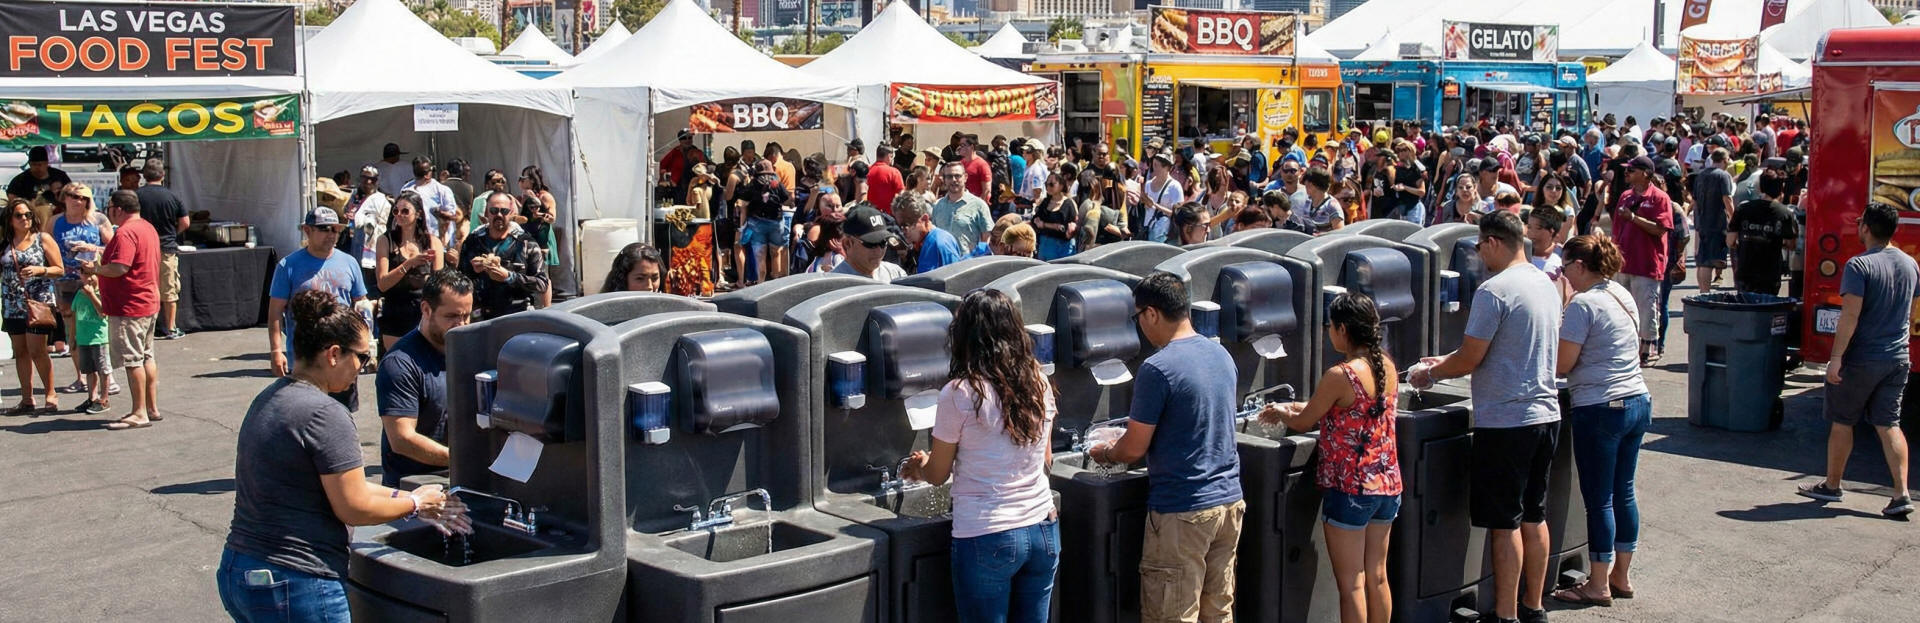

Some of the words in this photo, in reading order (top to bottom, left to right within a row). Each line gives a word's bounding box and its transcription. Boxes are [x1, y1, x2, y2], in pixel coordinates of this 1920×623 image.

[59, 9, 118, 32] LAS
[126, 10, 226, 33] VEGAS
[1197, 16, 1253, 51] BBQ
[9, 36, 150, 71] FOOD
[165, 37, 274, 71] FEST
[1471, 28, 1532, 50] GELATO
[46, 102, 245, 137] TACOS
[732, 102, 788, 128] BBQ
